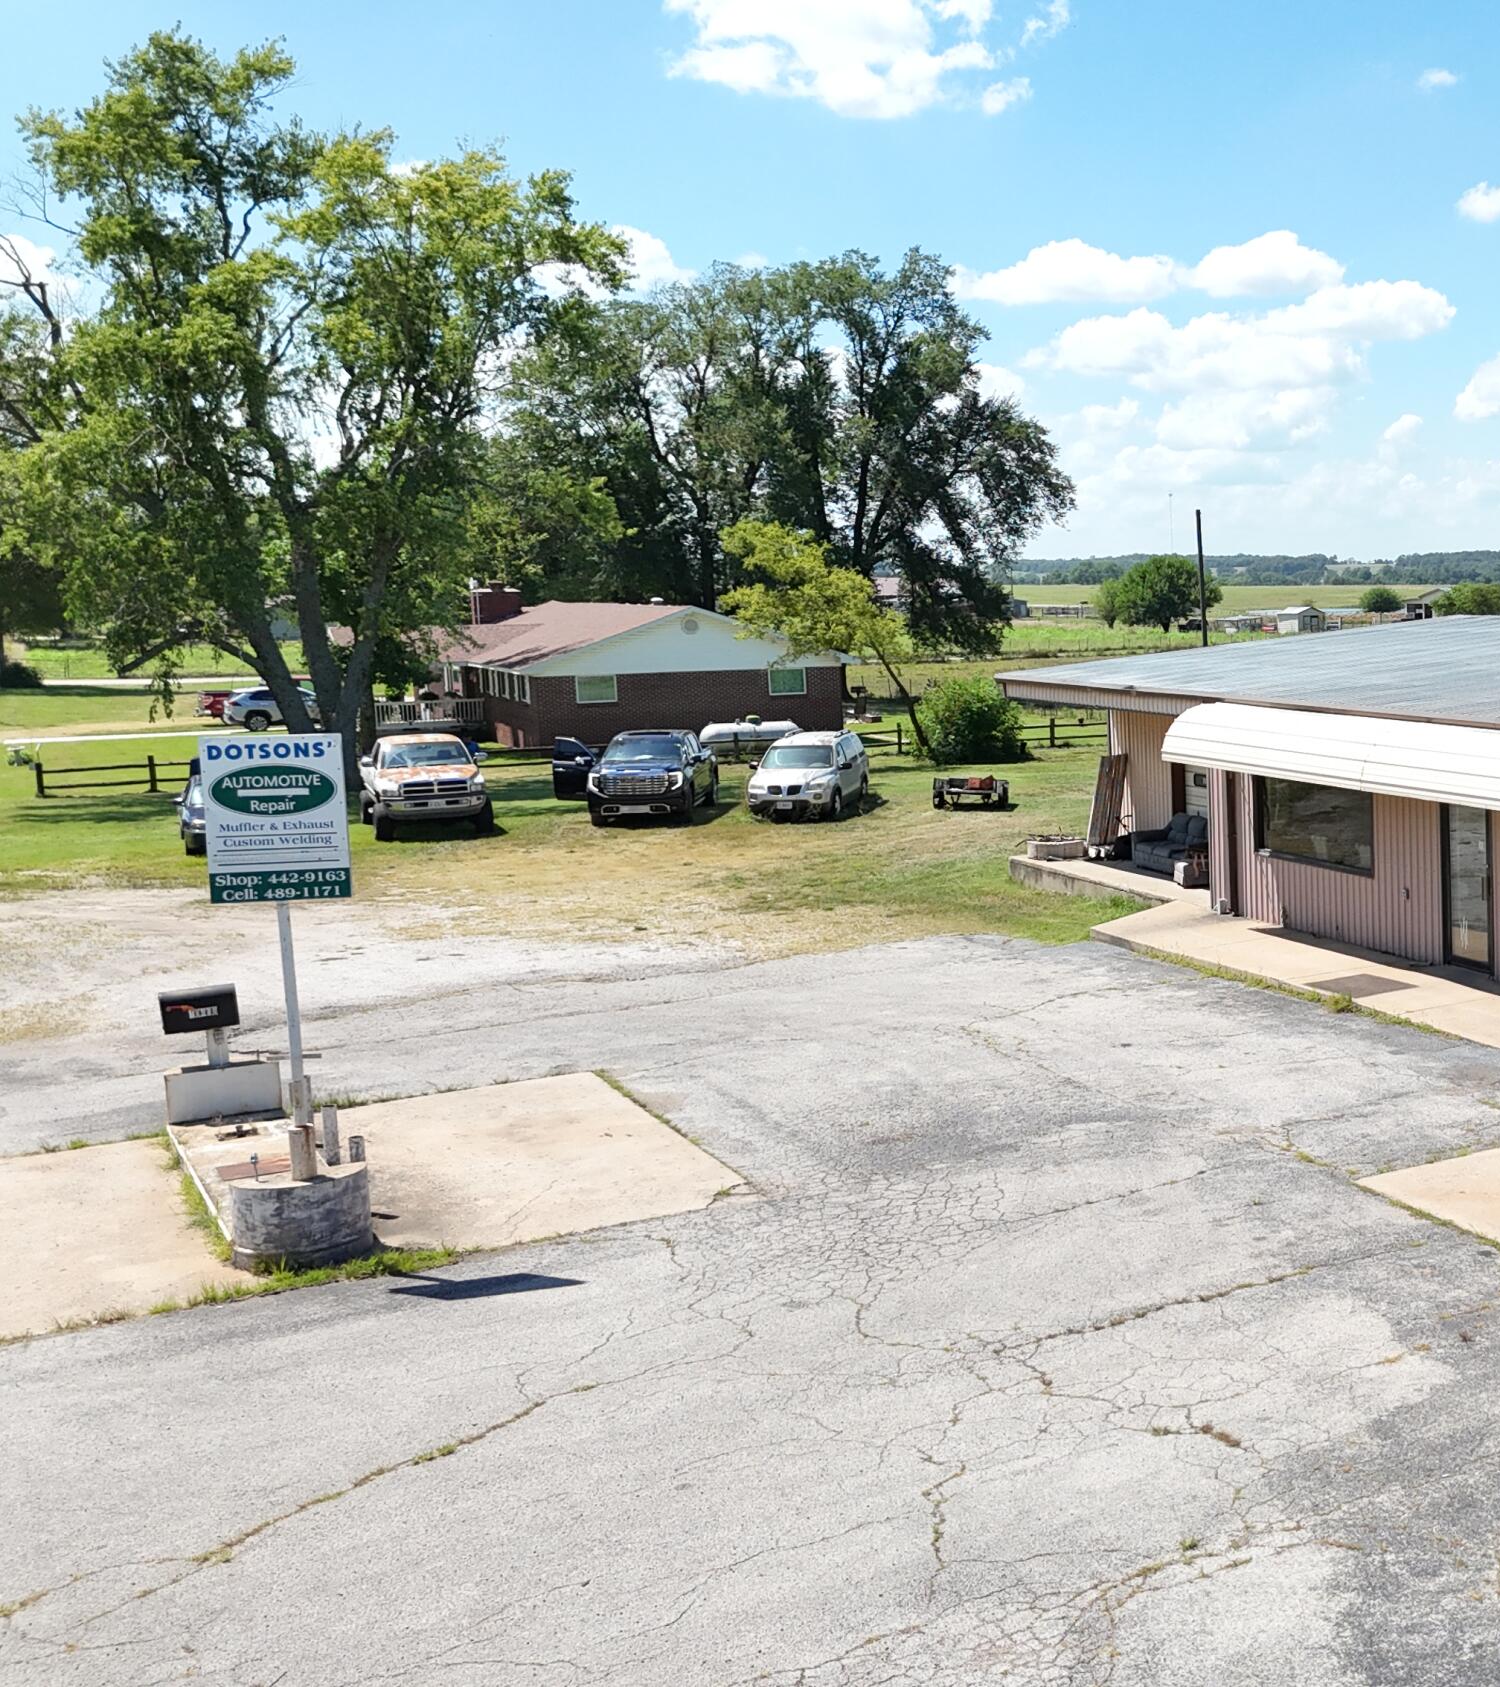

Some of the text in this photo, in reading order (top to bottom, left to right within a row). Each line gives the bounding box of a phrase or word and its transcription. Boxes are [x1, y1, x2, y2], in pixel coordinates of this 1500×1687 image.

[207, 741, 332, 760] DOTSONS'
[222, 774, 321, 789] AUTOMOTIVE
[250, 800, 296, 814] Repair
[219, 820, 334, 833] Muffler & Exhaust
[223, 835, 332, 848] Custom Welding
[215, 870, 346, 888] Shop: 442-9163
[222, 885, 341, 901] Cell: 489-1171
